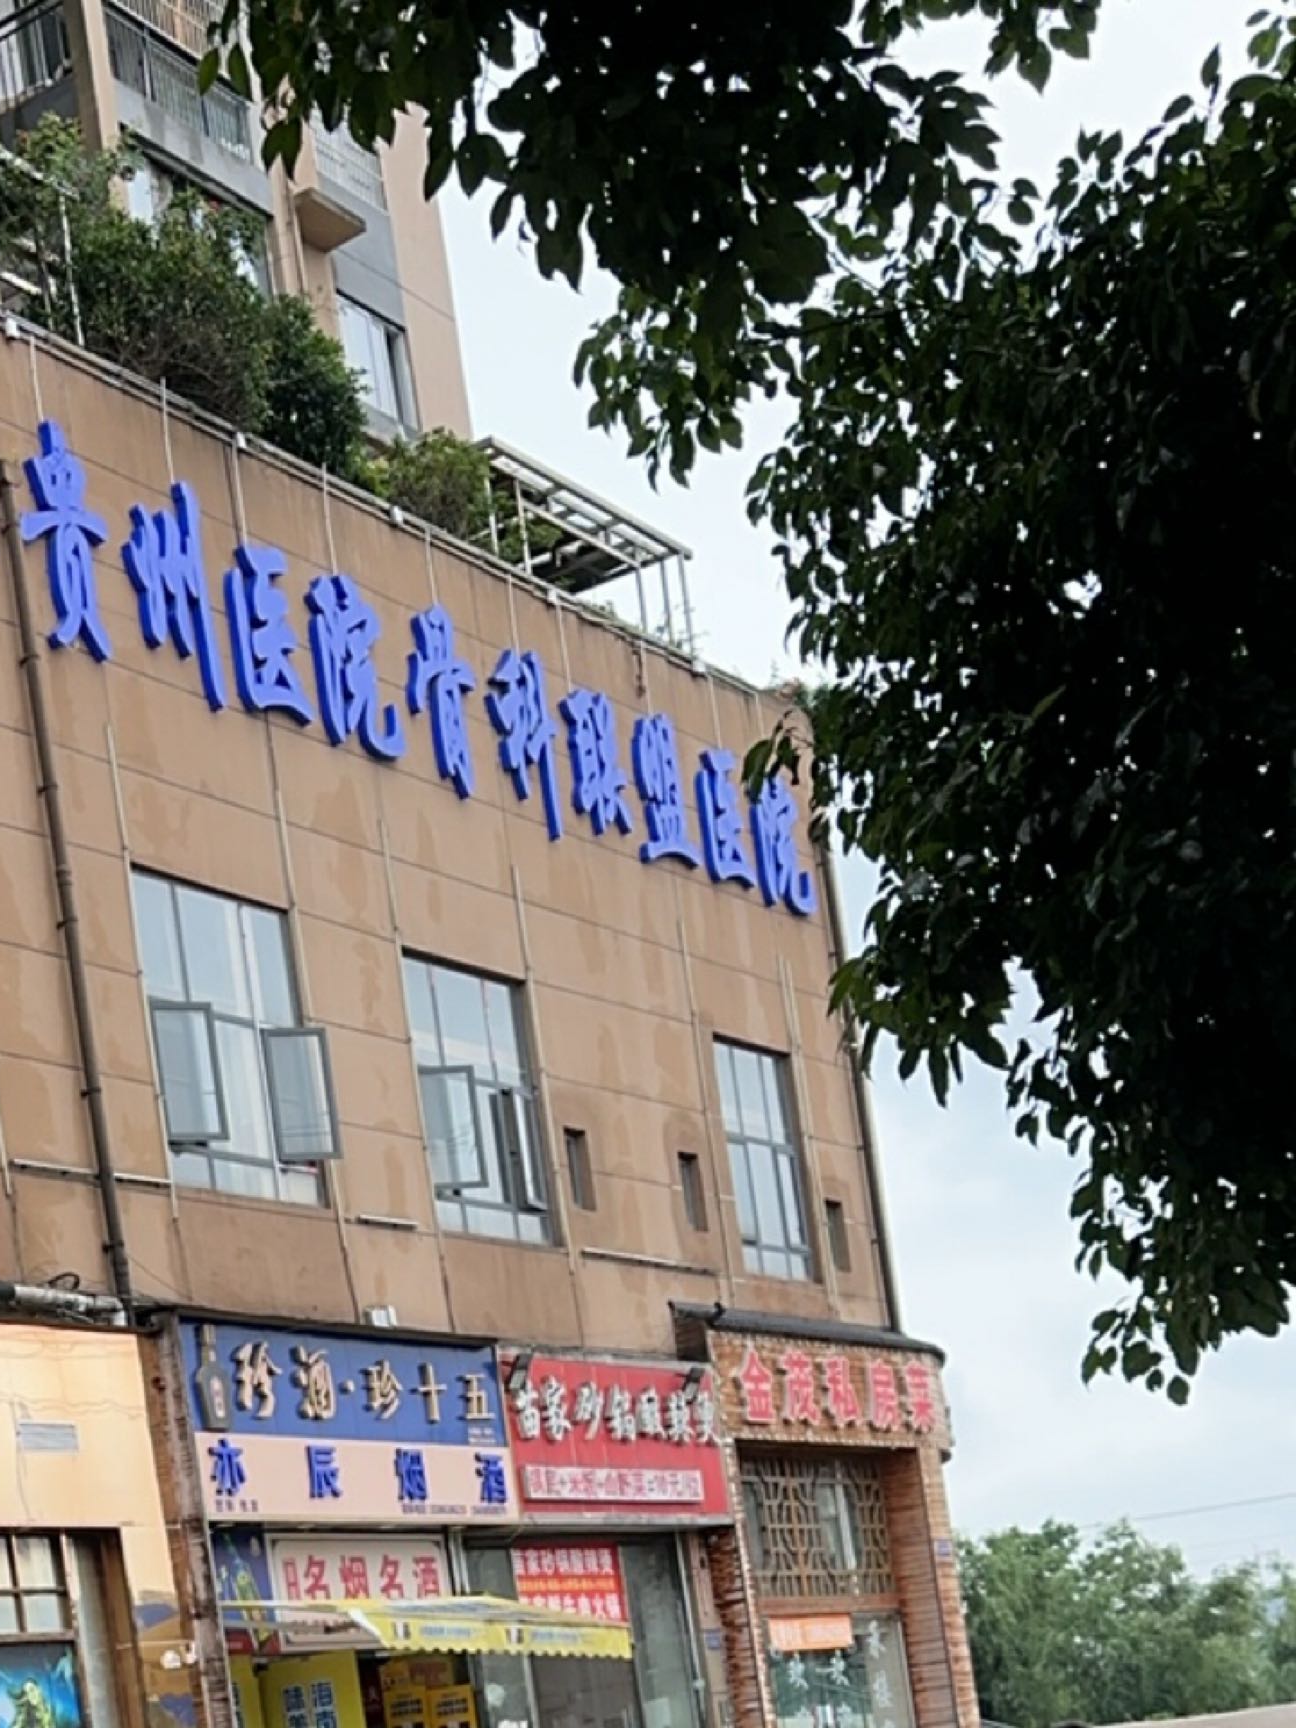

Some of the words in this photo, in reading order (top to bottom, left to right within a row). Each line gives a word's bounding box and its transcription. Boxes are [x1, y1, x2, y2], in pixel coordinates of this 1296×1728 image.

[739, 1350, 937, 1433] 金茂私房菜
[209, 1439, 508, 1504] 亦辰烟酒
